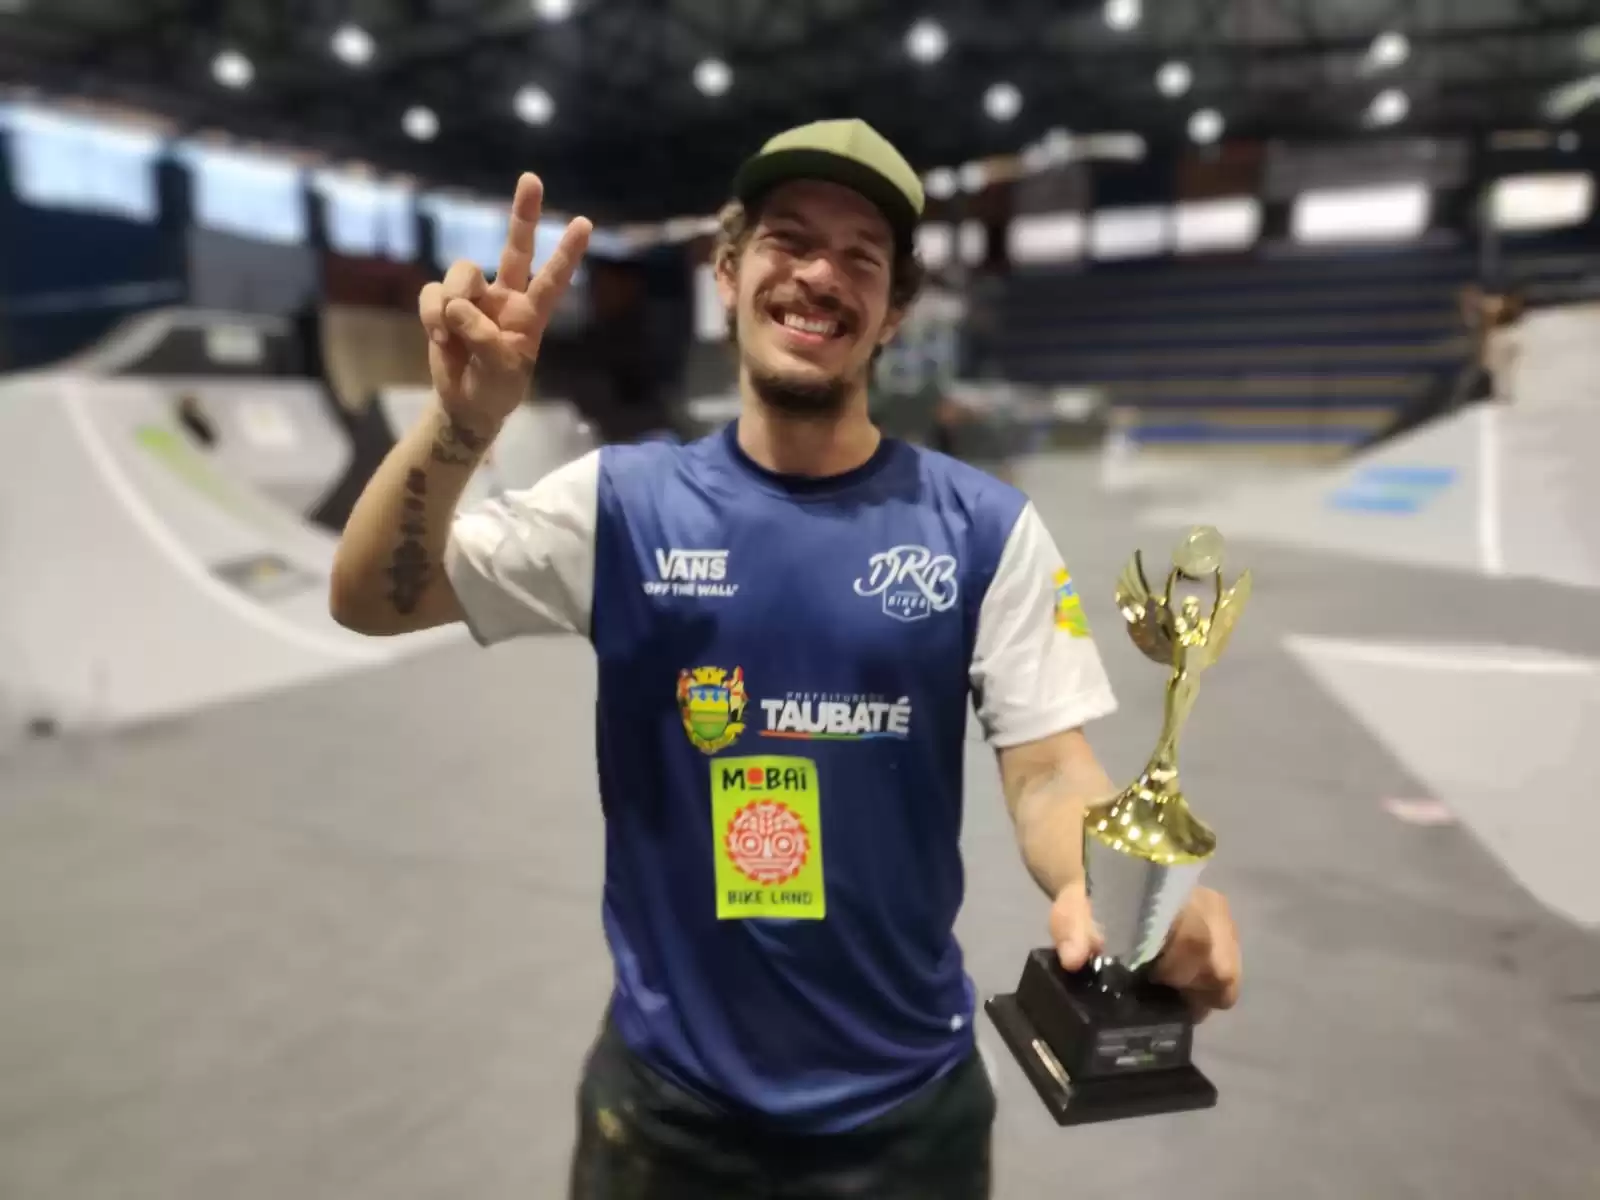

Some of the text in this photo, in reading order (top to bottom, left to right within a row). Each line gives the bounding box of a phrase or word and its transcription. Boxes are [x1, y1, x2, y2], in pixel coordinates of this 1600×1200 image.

[655, 548, 729, 580] VANS
[760, 696, 911, 734] TAUBATÉ
[727, 889, 763, 905] BIKE
